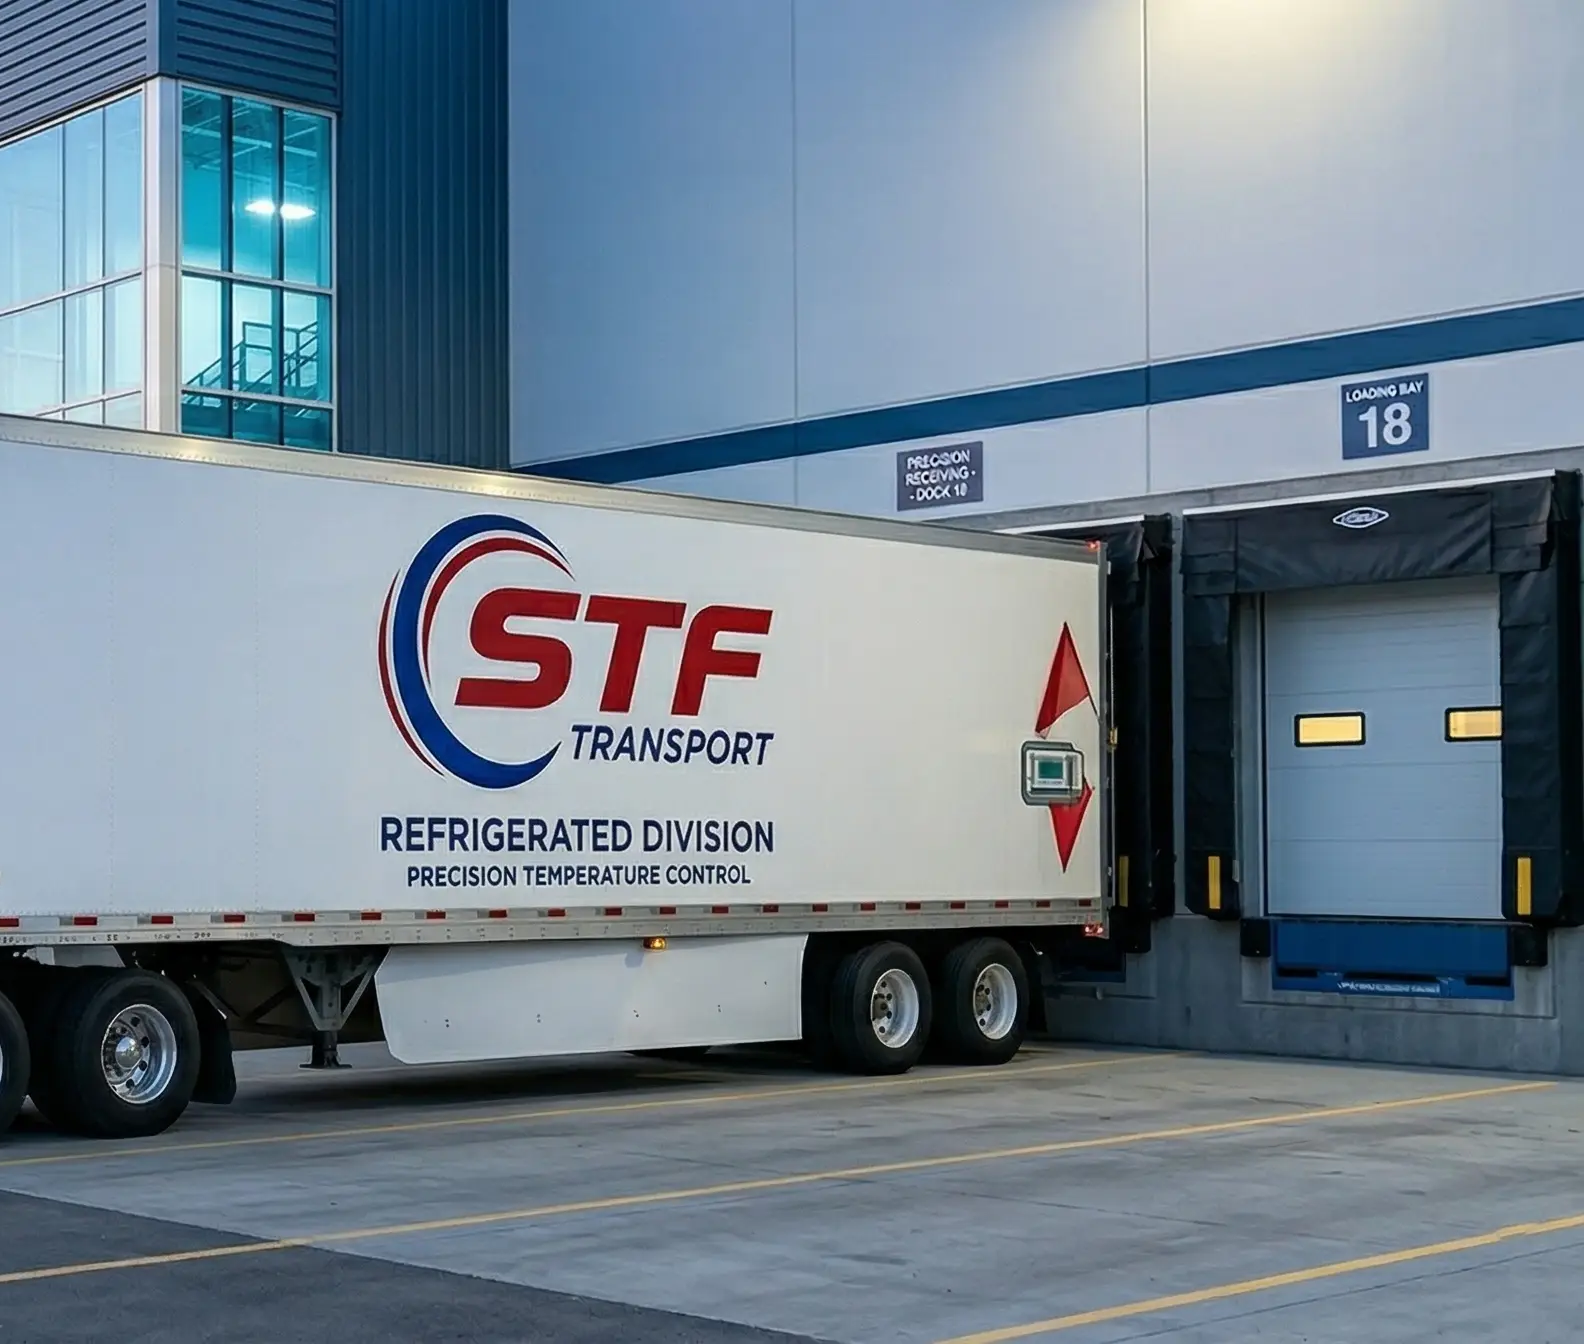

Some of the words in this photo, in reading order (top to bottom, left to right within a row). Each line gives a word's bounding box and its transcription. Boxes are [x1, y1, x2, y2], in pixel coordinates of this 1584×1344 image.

[1346, 384, 1397, 403] LOADING
[1359, 402, 1412, 448] 18
[917, 485, 951, 501] DOCK
[453, 587, 774, 717] STF
[571, 723, 775, 766] TRANSPORT
[380, 816, 633, 853] REFRIGERATED
[642, 819, 775, 853] DIVISION
[407, 864, 517, 888] PRECISION
[522, 865, 661, 887] TEMPERATURE
[665, 864, 751, 886] CONTROL
